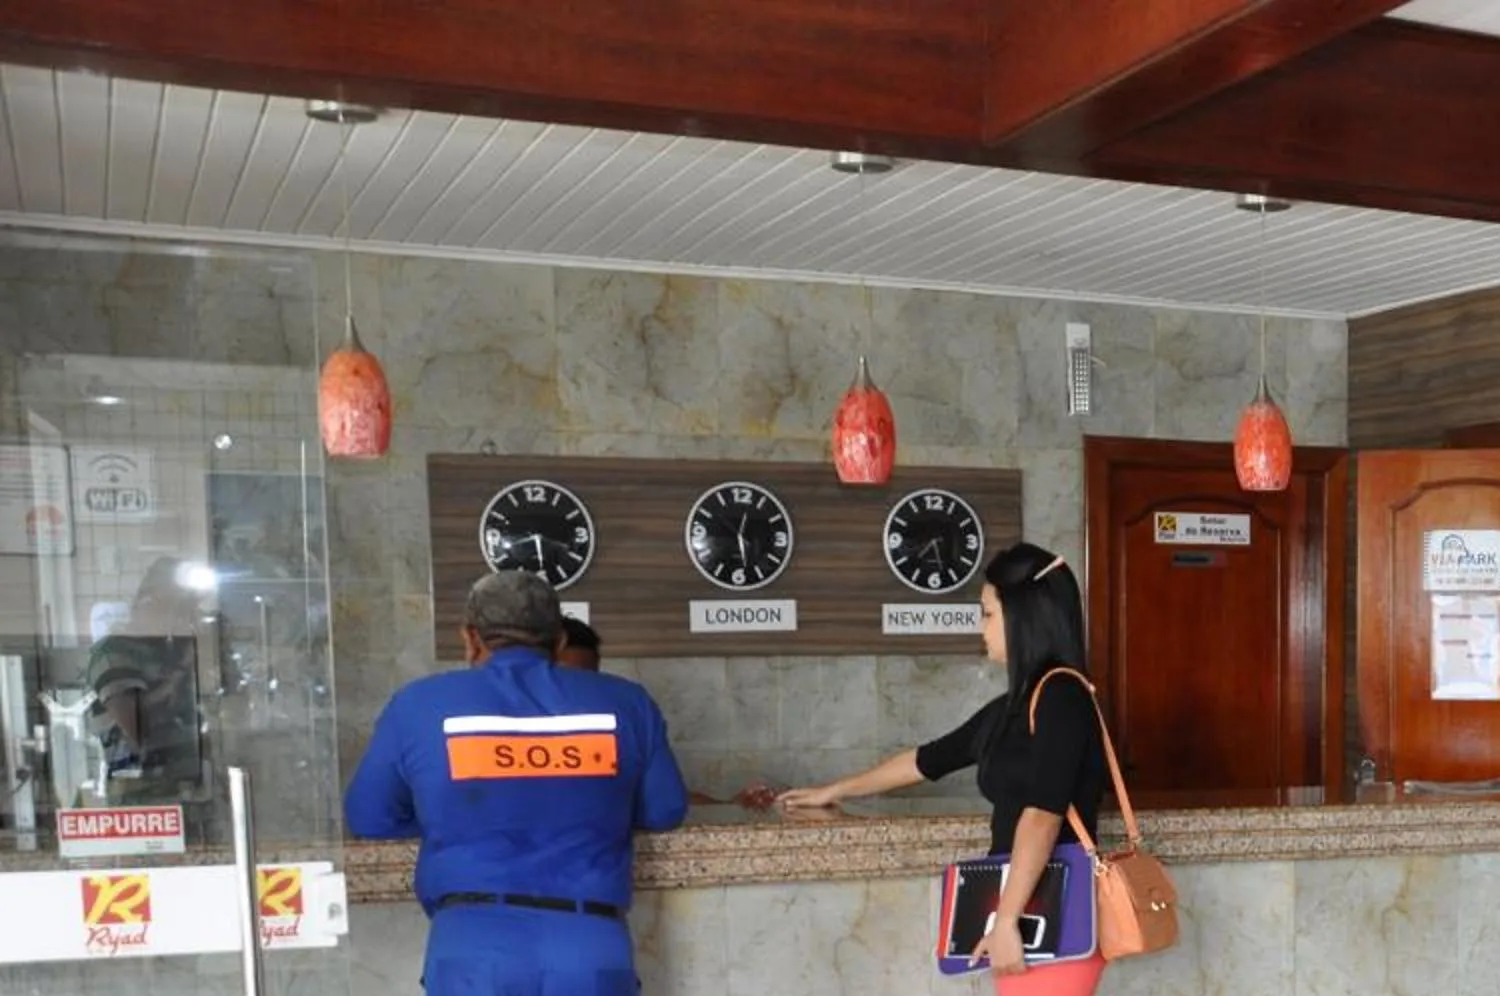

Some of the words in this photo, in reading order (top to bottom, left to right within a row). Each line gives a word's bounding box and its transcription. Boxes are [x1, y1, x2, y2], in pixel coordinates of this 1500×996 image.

[523, 487, 546, 502] 12
[732, 487, 752, 504] 12
[924, 495, 944, 510] 12
[575, 527, 588, 542] 3
[774, 532, 787, 547] 3
[965, 534, 978, 550] 3
[732, 567, 746, 585] 6
[928, 572, 941, 588] 6
[705, 607, 781, 625] LONDON
[888, 611, 925, 626] NEW
[931, 611, 976, 626] YORK
[62, 812, 179, 836] EMPURRE
[259, 915, 299, 945] yad
[86, 924, 148, 954] Ryad
